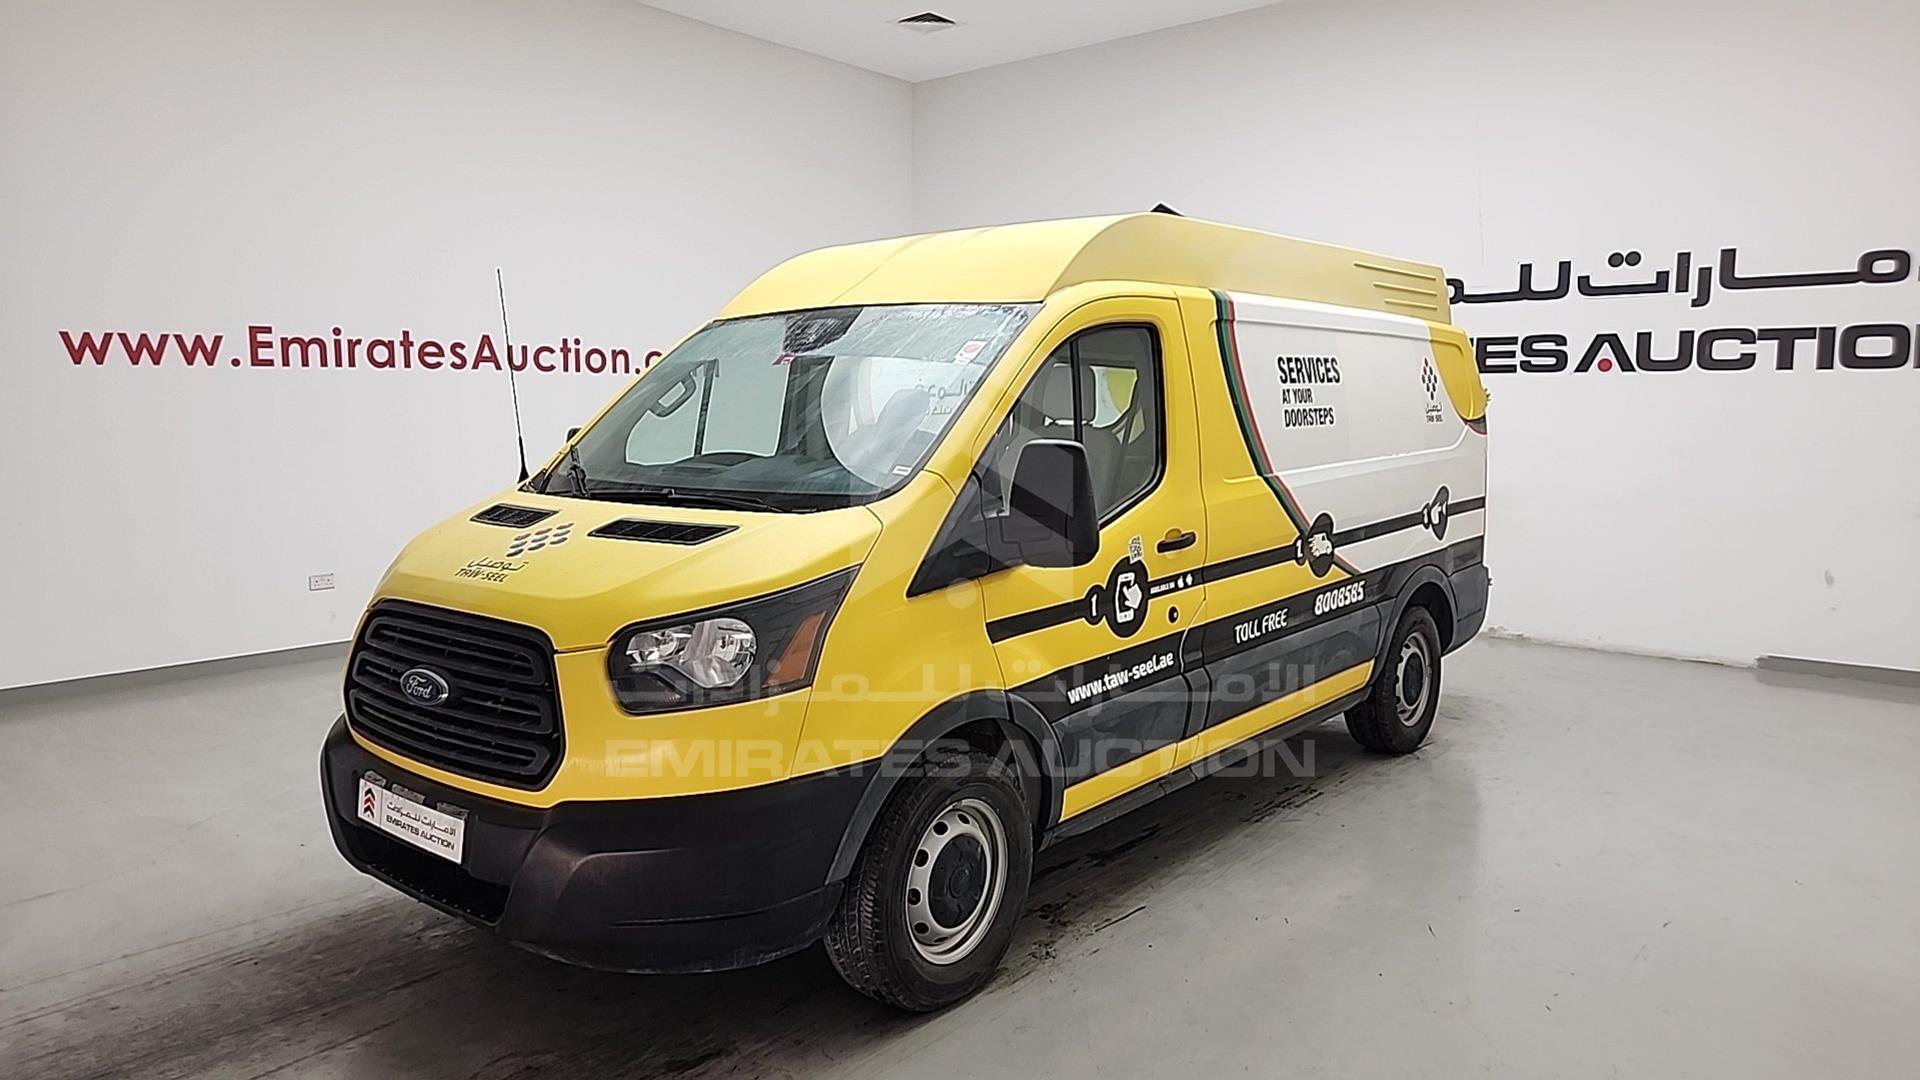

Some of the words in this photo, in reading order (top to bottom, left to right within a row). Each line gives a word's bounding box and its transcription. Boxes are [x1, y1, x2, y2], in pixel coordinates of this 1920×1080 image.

[1577, 248, 1920, 307] مارات
[1469, 334, 1568, 374] ES
[1573, 323, 1920, 374] AUCTIO
[1277, 356, 1341, 384] SERVICES
[1282, 388, 1292, 405] AT
[1293, 387, 1313, 404] YOUR
[1284, 407, 1335, 427] DOORSTEPS
[454, 567, 509, 583] TAW-SEEL
[1314, 580, 1366, 615] 8008585
[1234, 614, 1261, 644] TOLL
[1261, 607, 1289, 634] FREE
[406, 674, 432, 699] Ford
[386, 815, 420, 836] EMIRATES
[420, 830, 455, 850] AUCTION
